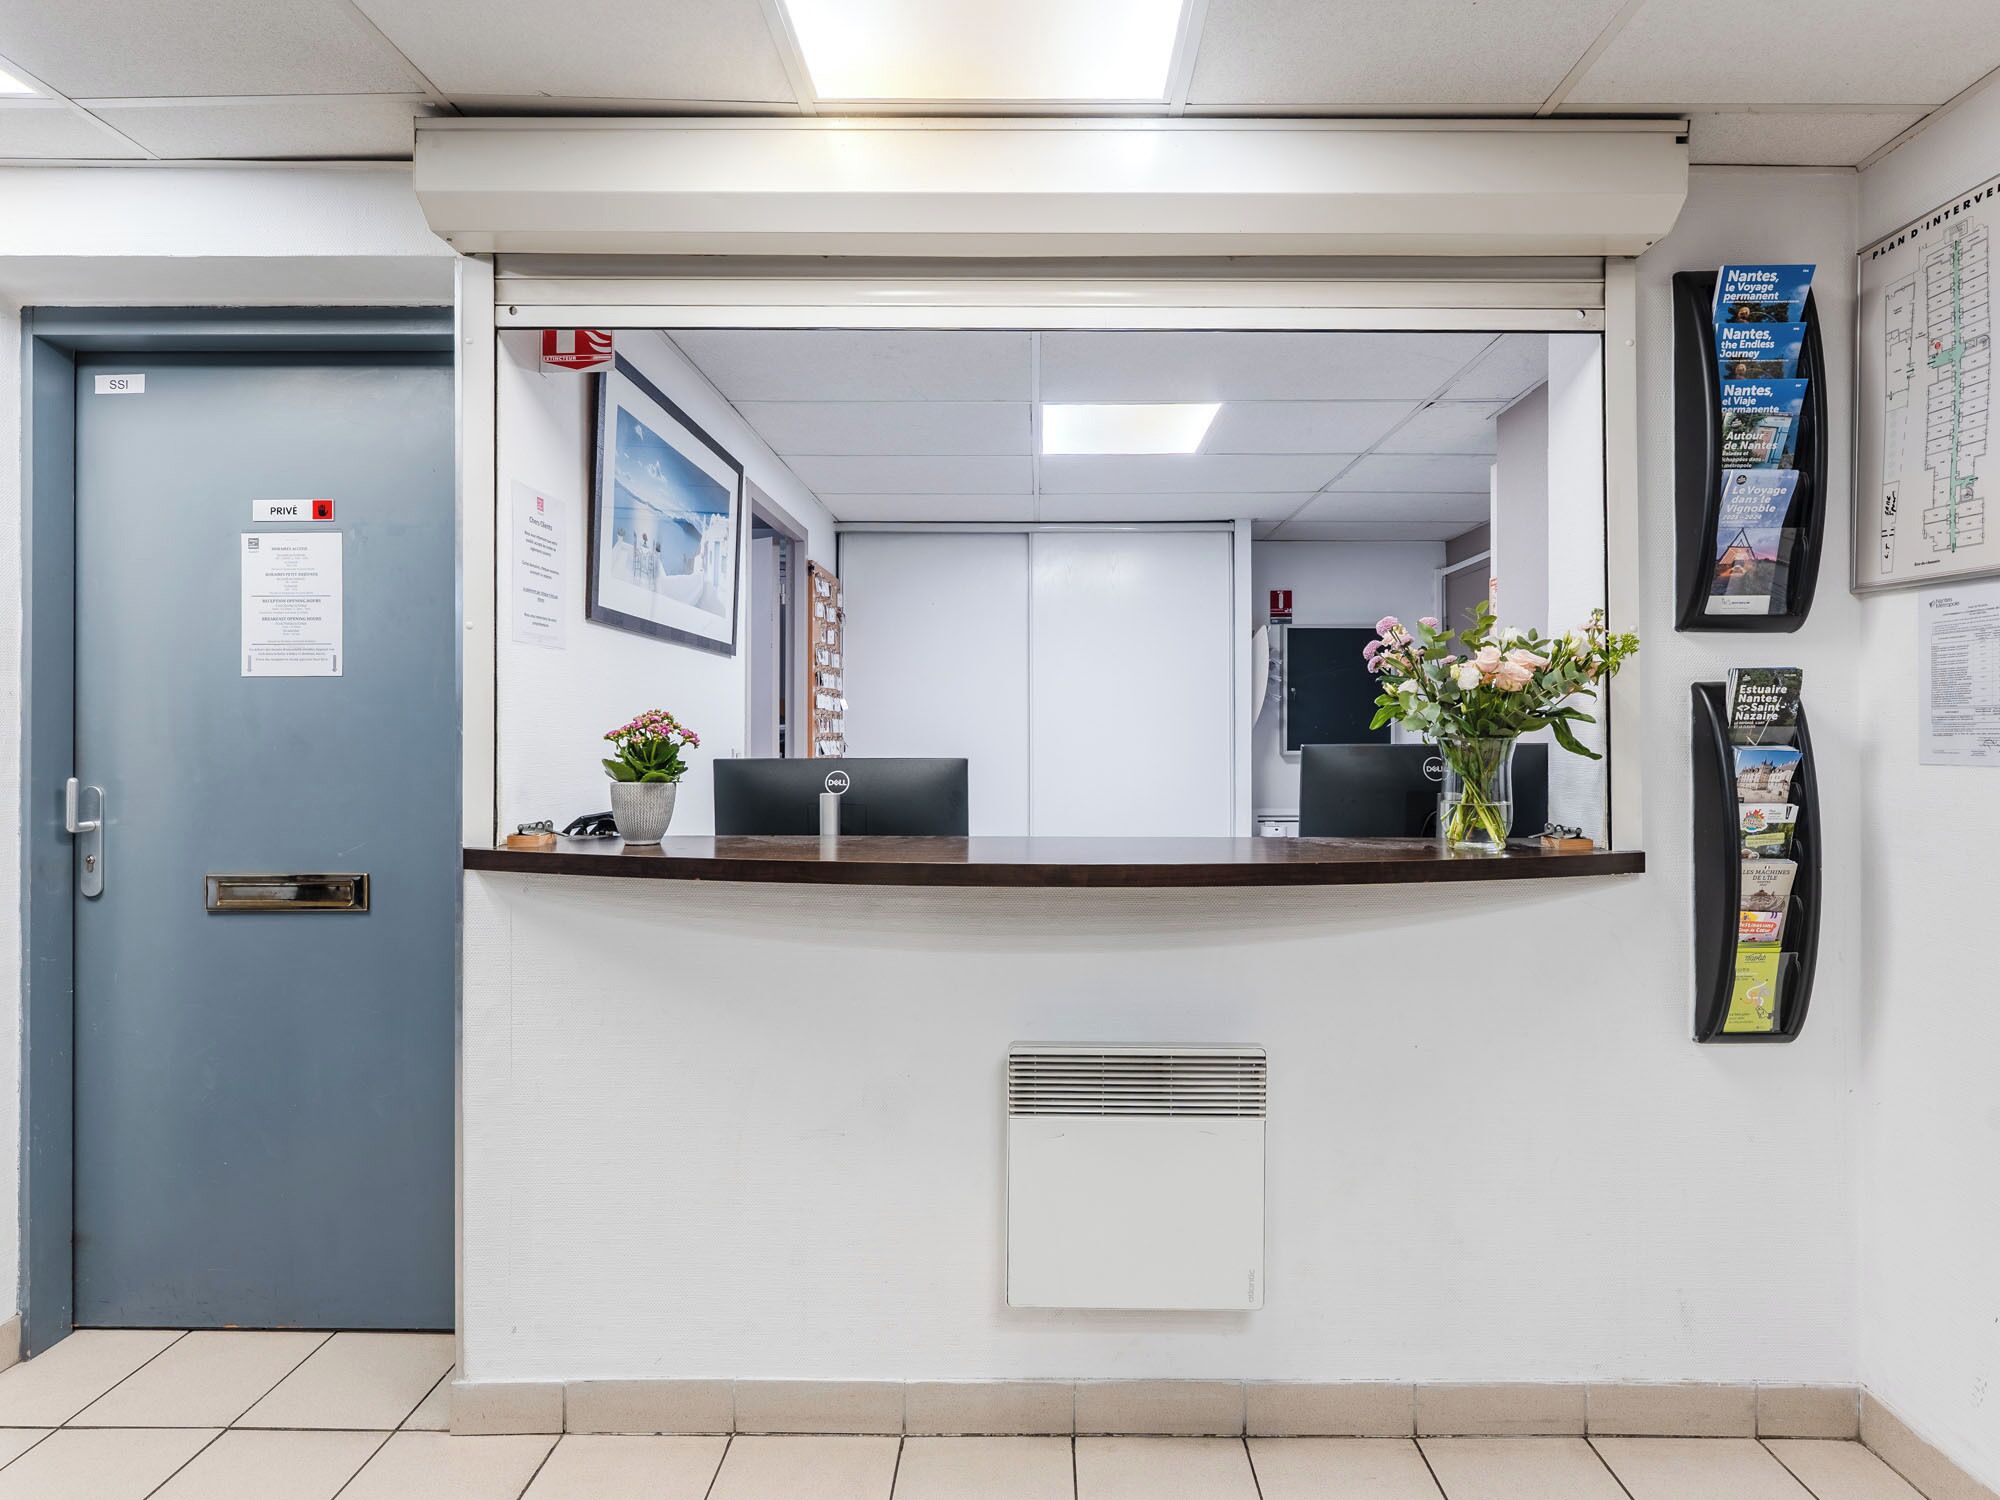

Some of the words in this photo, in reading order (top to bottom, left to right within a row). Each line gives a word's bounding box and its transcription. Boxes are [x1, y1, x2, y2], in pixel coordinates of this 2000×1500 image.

[1872, 235, 1905, 260] PLAN
[1727, 270, 1779, 283] Nantes,
[1725, 283, 1735, 292] le
[1738, 283, 1774, 293] Voyage
[1723, 291, 1779, 303] permanent
[1722, 328, 1772, 341] Nantes,
[1721, 340, 1737, 349] the
[1740, 340, 1775, 349] Endless
[1719, 349, 1760, 359] Journey
[109, 379, 129, 390] SSI
[1723, 384, 1774, 397] Nantes,
[1722, 397, 1731, 406] el
[1734, 397, 1756, 407] Viaje
[1721, 405, 1779, 413] permanente
[1725, 431, 1764, 440] Autour
[1723, 441, 1737, 450] de
[1739, 441, 1777, 450] Nantes
[1732, 486, 1745, 495] Le
[1748, 486, 1788, 496] Voyage
[1731, 495, 1758, 504] dans
[1760, 495, 1772, 504] le
[270, 504, 298, 515] PRIVÉ
[1726, 504, 1776, 514] Vignoble
[1739, 684, 1788, 694] Estuaire
[1737, 694, 1778, 703] Nantes
[1735, 712, 1779, 721] Nazaire
